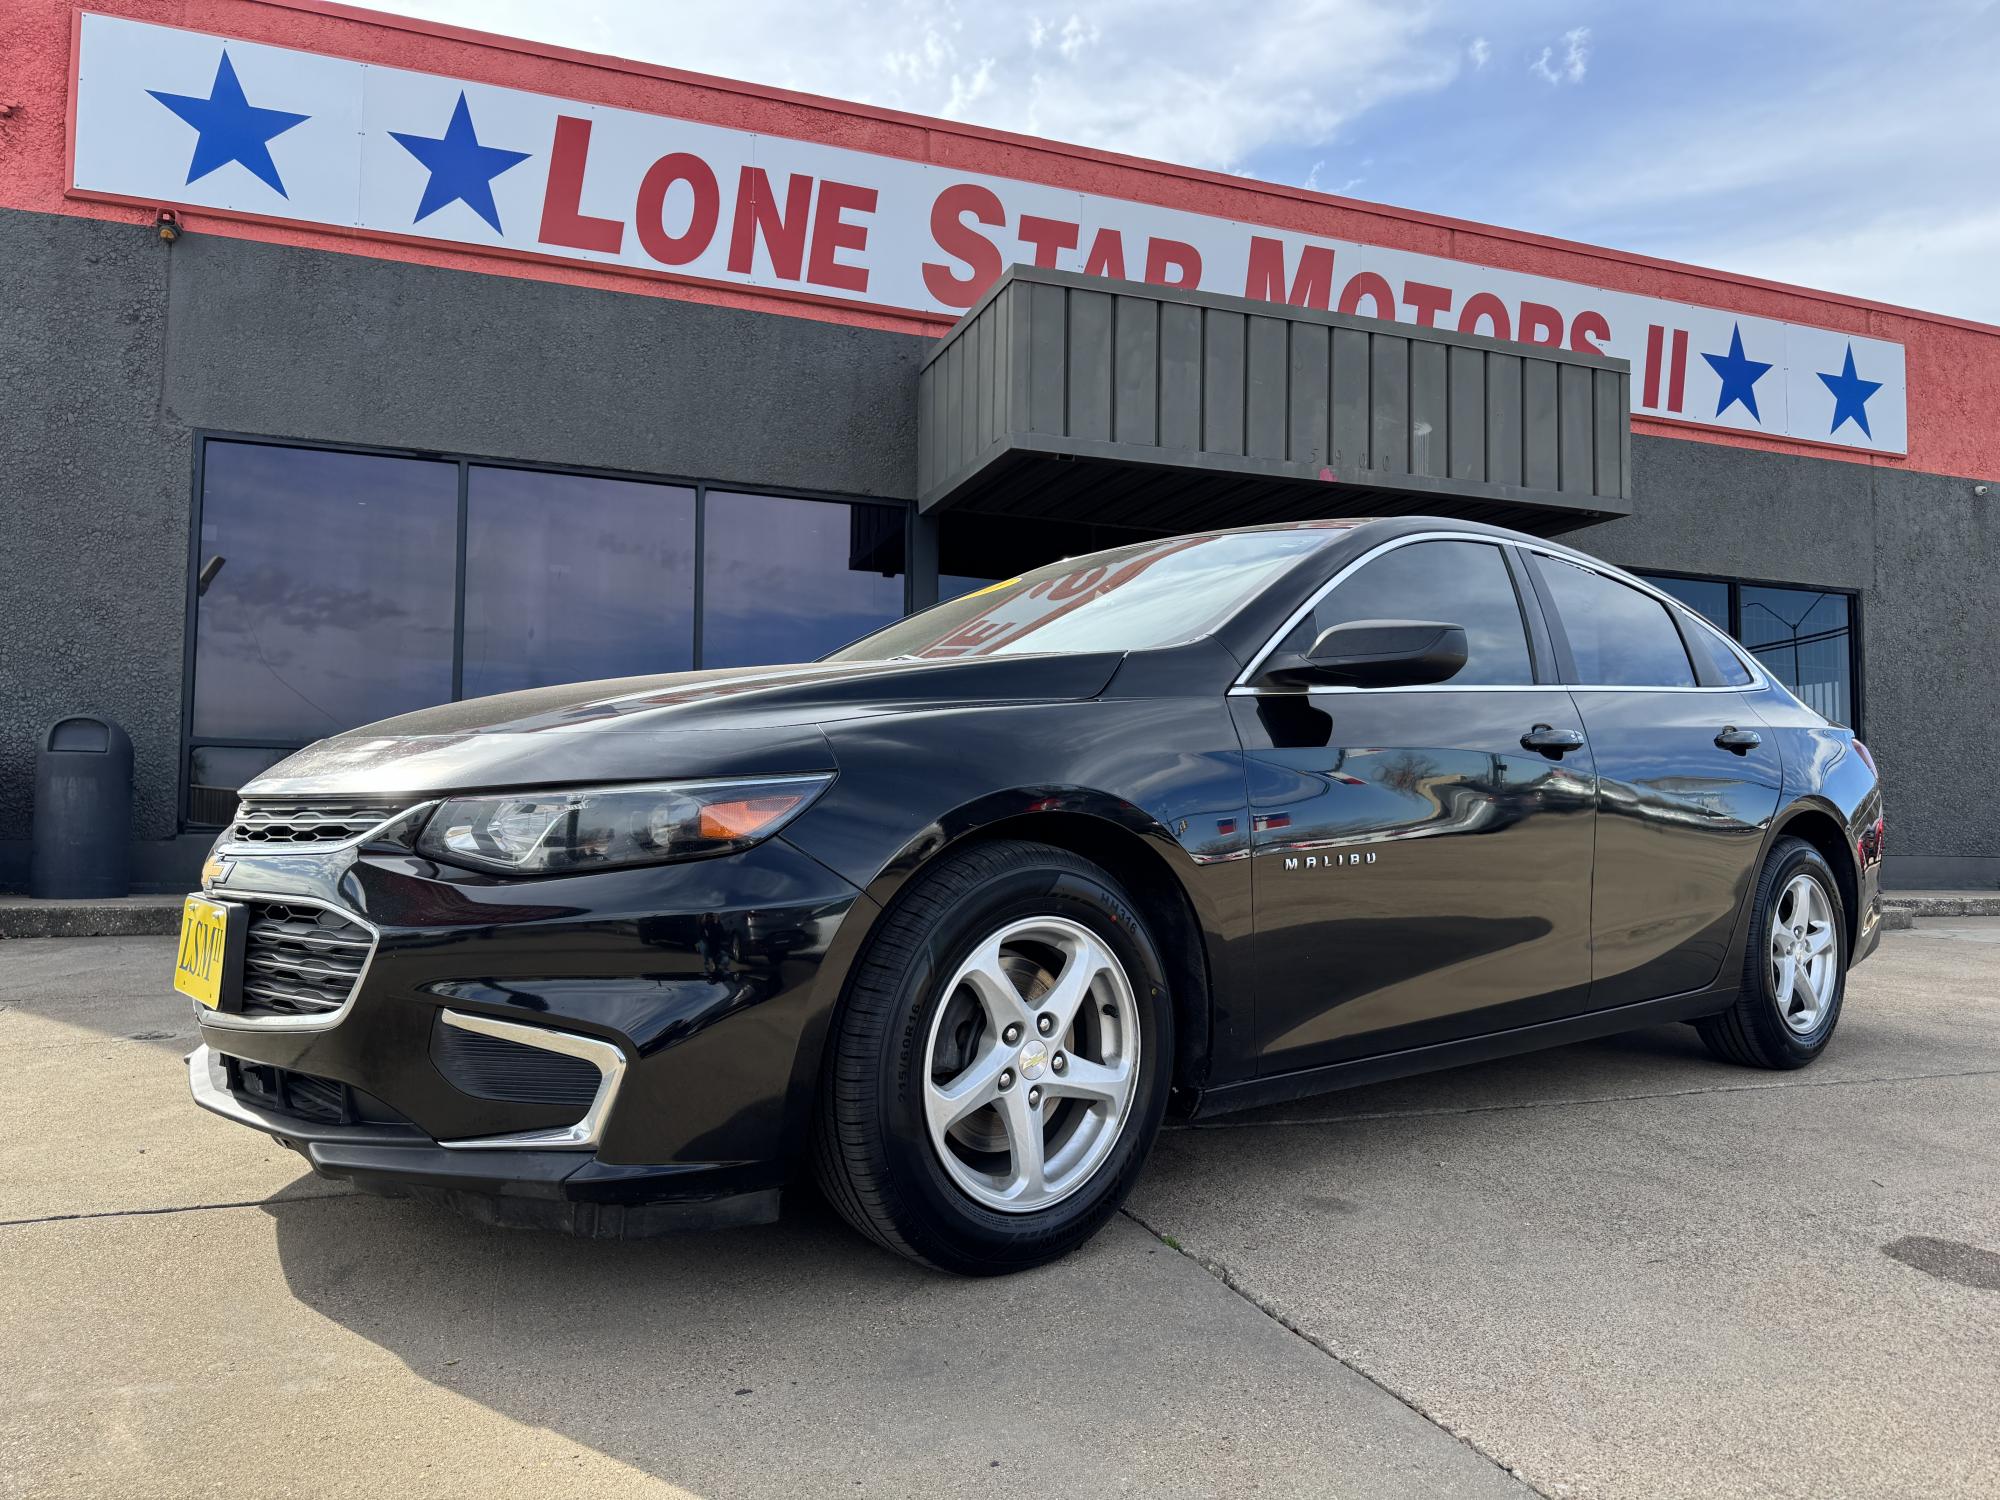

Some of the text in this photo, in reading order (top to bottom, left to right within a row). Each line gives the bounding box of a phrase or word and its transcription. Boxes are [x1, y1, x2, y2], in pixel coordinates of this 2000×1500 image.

[538, 115, 878, 293] LONE
[1642, 324, 1688, 413] II
[1284, 852, 1376, 871] MALIBU
